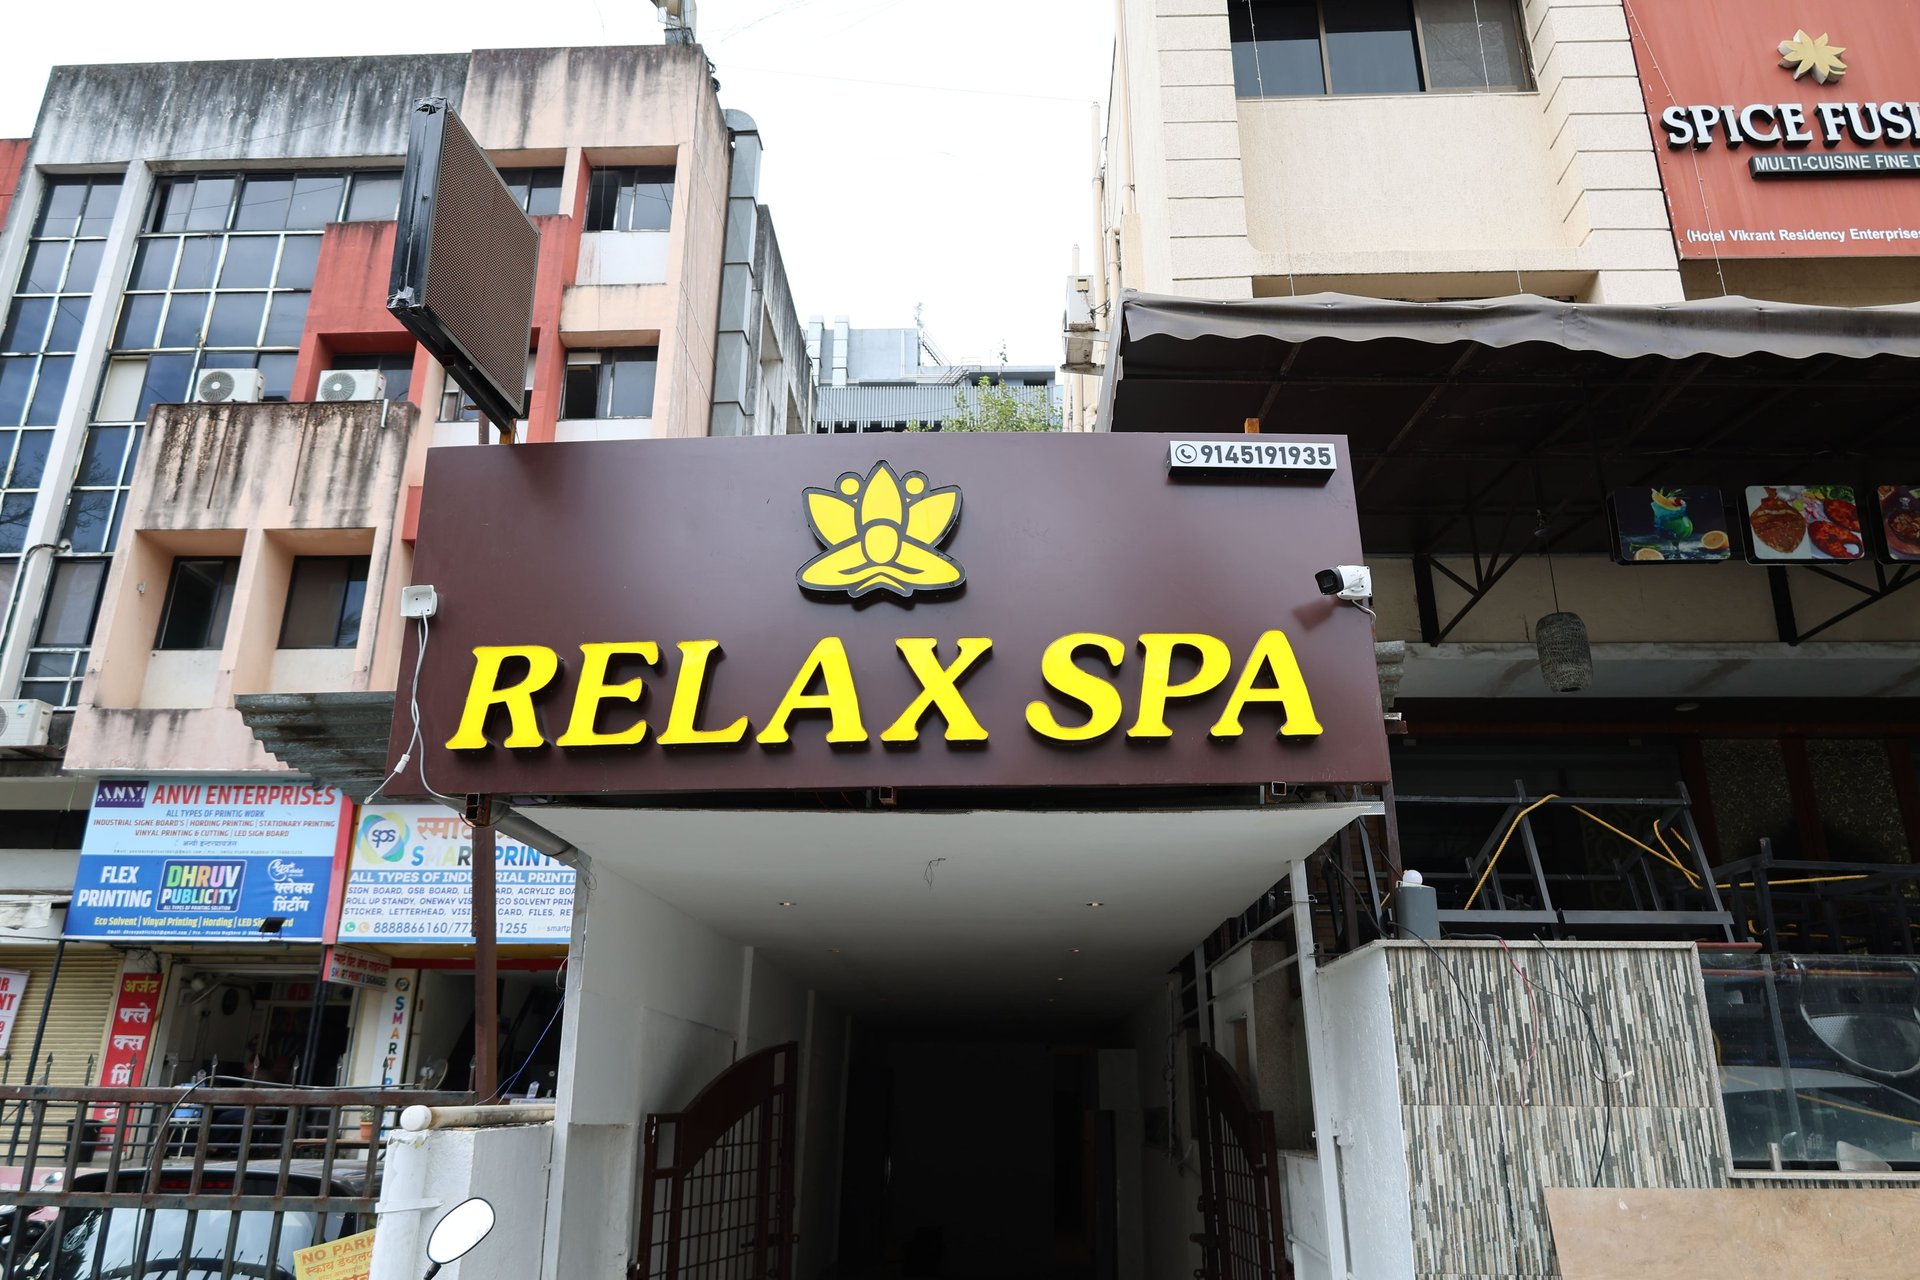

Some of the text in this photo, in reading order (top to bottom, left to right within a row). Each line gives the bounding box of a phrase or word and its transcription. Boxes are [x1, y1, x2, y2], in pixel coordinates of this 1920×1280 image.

[1660, 103, 1813, 149] SPICE
[1755, 155, 1869, 171] MULTI-CUISINE
[1875, 155, 1910, 170] FINE
[1687, 228, 1920, 243] (Hotel Vikrant Residency Enterprise
[1201, 445, 1331, 466] 9145191935
[445, 629, 1324, 752] RELAX SPA
[97, 786, 147, 799] ANVI
[152, 784, 336, 806] ANVI ENTERPRISES
[166, 810, 178, 818] ALL
[181, 810, 202, 818] TYPES
[204, 810, 213, 818] OF
[245, 810, 265, 818] WORK
[93, 819, 132, 827] INDUSTRIAL
[260, 820, 301, 828] STATIONARY
[161, 829, 193, 837] PRINTING
[372, 829, 396, 848] sps
[411, 846, 472, 866] SAR
[101, 866, 140, 883] FLEX
[166, 866, 241, 887] DHRUV
[349, 872, 374, 883] ALL
[378, 872, 419, 883] TYPES
[422, 872, 440, 883] OF
[442, 872, 526, 883] INDURIAL
[77, 889, 152, 907] PRINTING
[161, 889, 238, 904] PUBLICITY
[348, 887, 369, 895] SIGN
[518, 887, 555, 895] ACRYLIC
[345, 897, 366, 905] ROLL
[369, 897, 380, 905] UP
[420, 897, 456, 905] ONEWAY
[513, 897, 551, 906] SOLVENT
[553, 898, 573, 906] PRIN
[94, 917, 107, 926] Eco
[109, 917, 137, 926] Solvent
[167, 917, 198, 928] Printing
[202, 918, 233, 928] Hording
[238, 918, 252, 927] LED
[253, 918, 267, 928] Sig
[301, 1249, 327, 1265] NO
